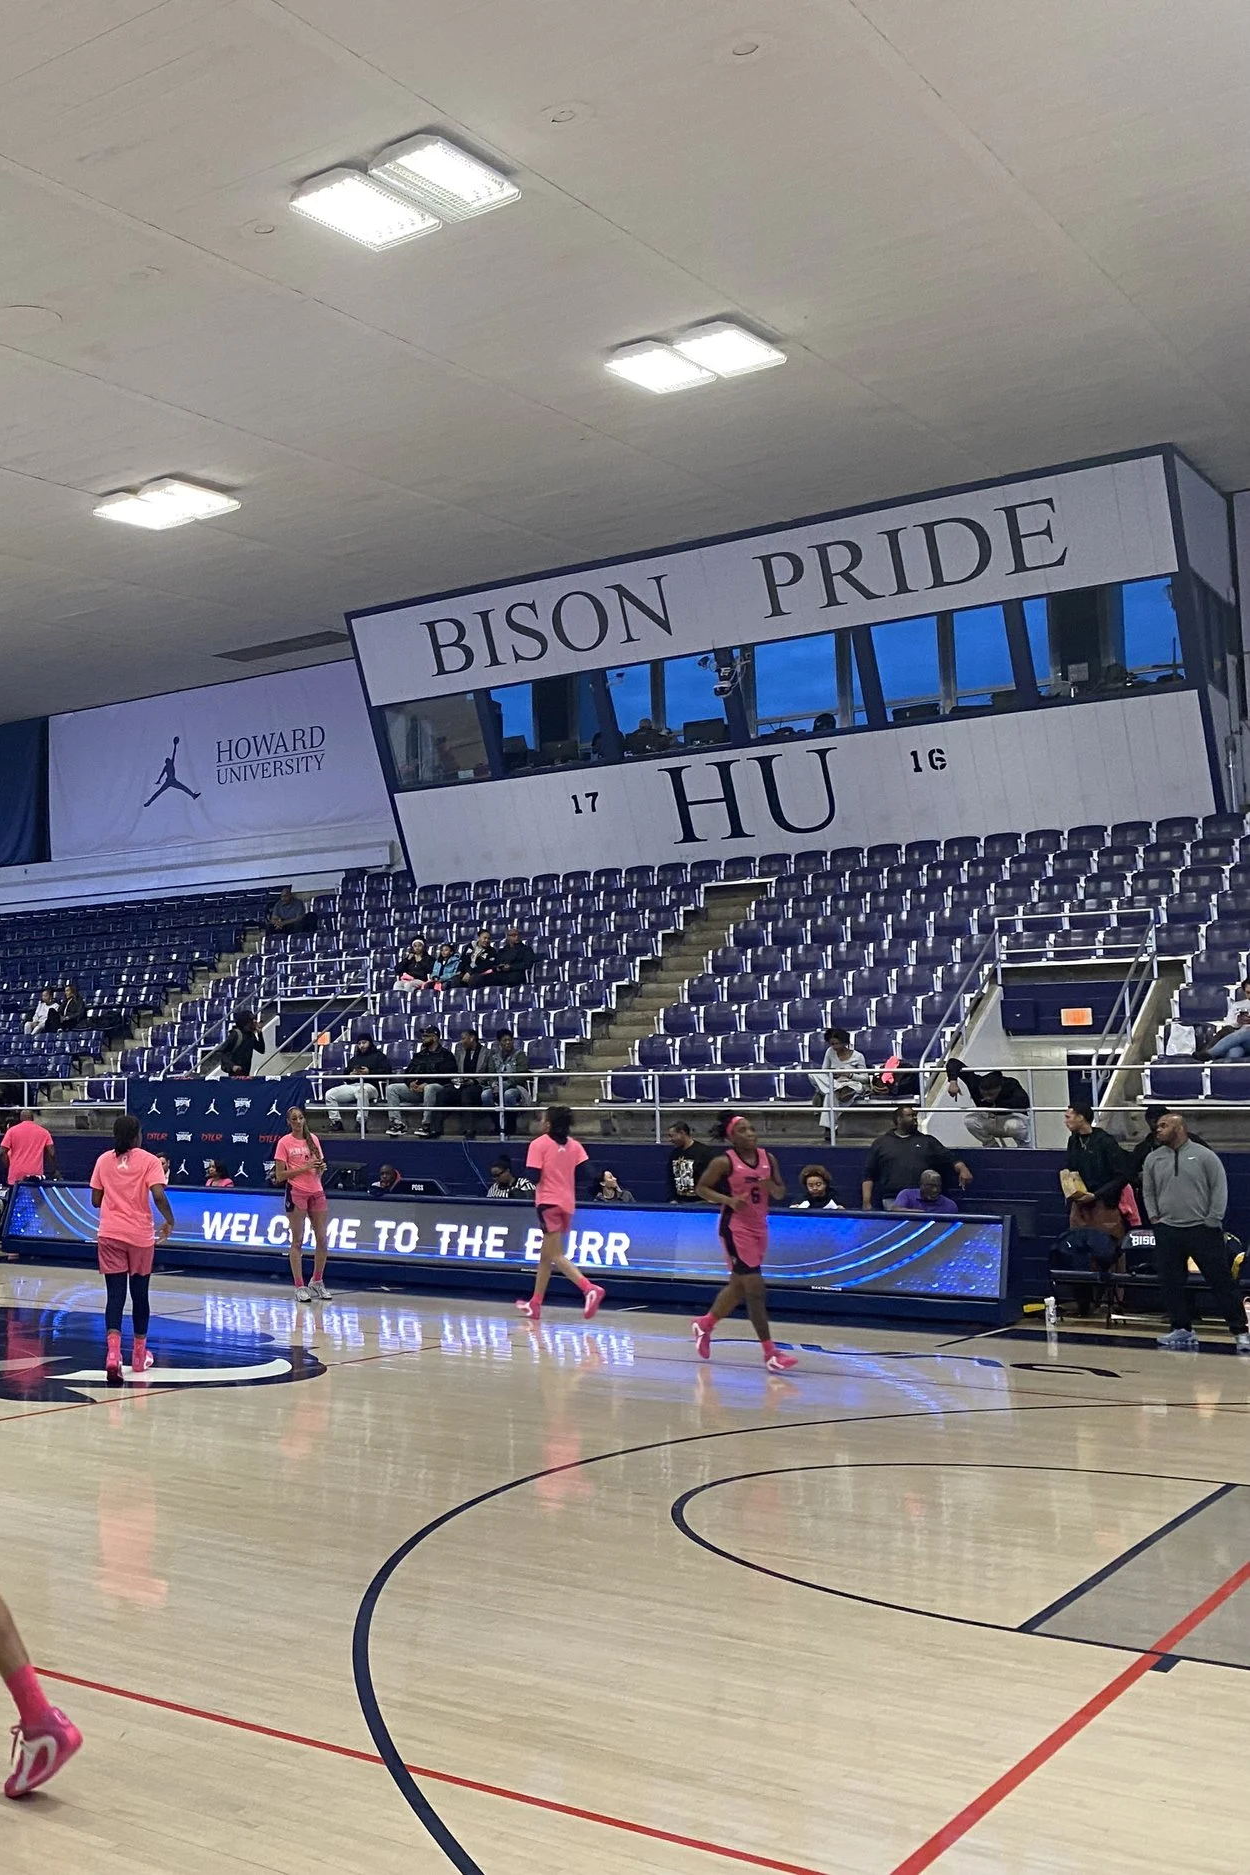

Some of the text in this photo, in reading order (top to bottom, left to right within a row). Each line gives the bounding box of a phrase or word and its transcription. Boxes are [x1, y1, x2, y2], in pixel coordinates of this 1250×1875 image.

[420, 497, 1067, 678] BISON PRIDE
[216, 725, 326, 763] HOWARD
[216, 753, 325, 785] UNIVERSITY
[909, 747, 948, 773] 16
[572, 791, 600, 815] 17
[658, 746, 837, 845] HU
[147, 1132, 169, 1141] DTLR
[201, 1132, 223, 1142] DTLR
[202, 1210, 362, 1250] WELCME
[375, 1220, 420, 1253] TO
[435, 1223, 508, 1259] THE
[1130, 1233, 1156, 1247] BISO
